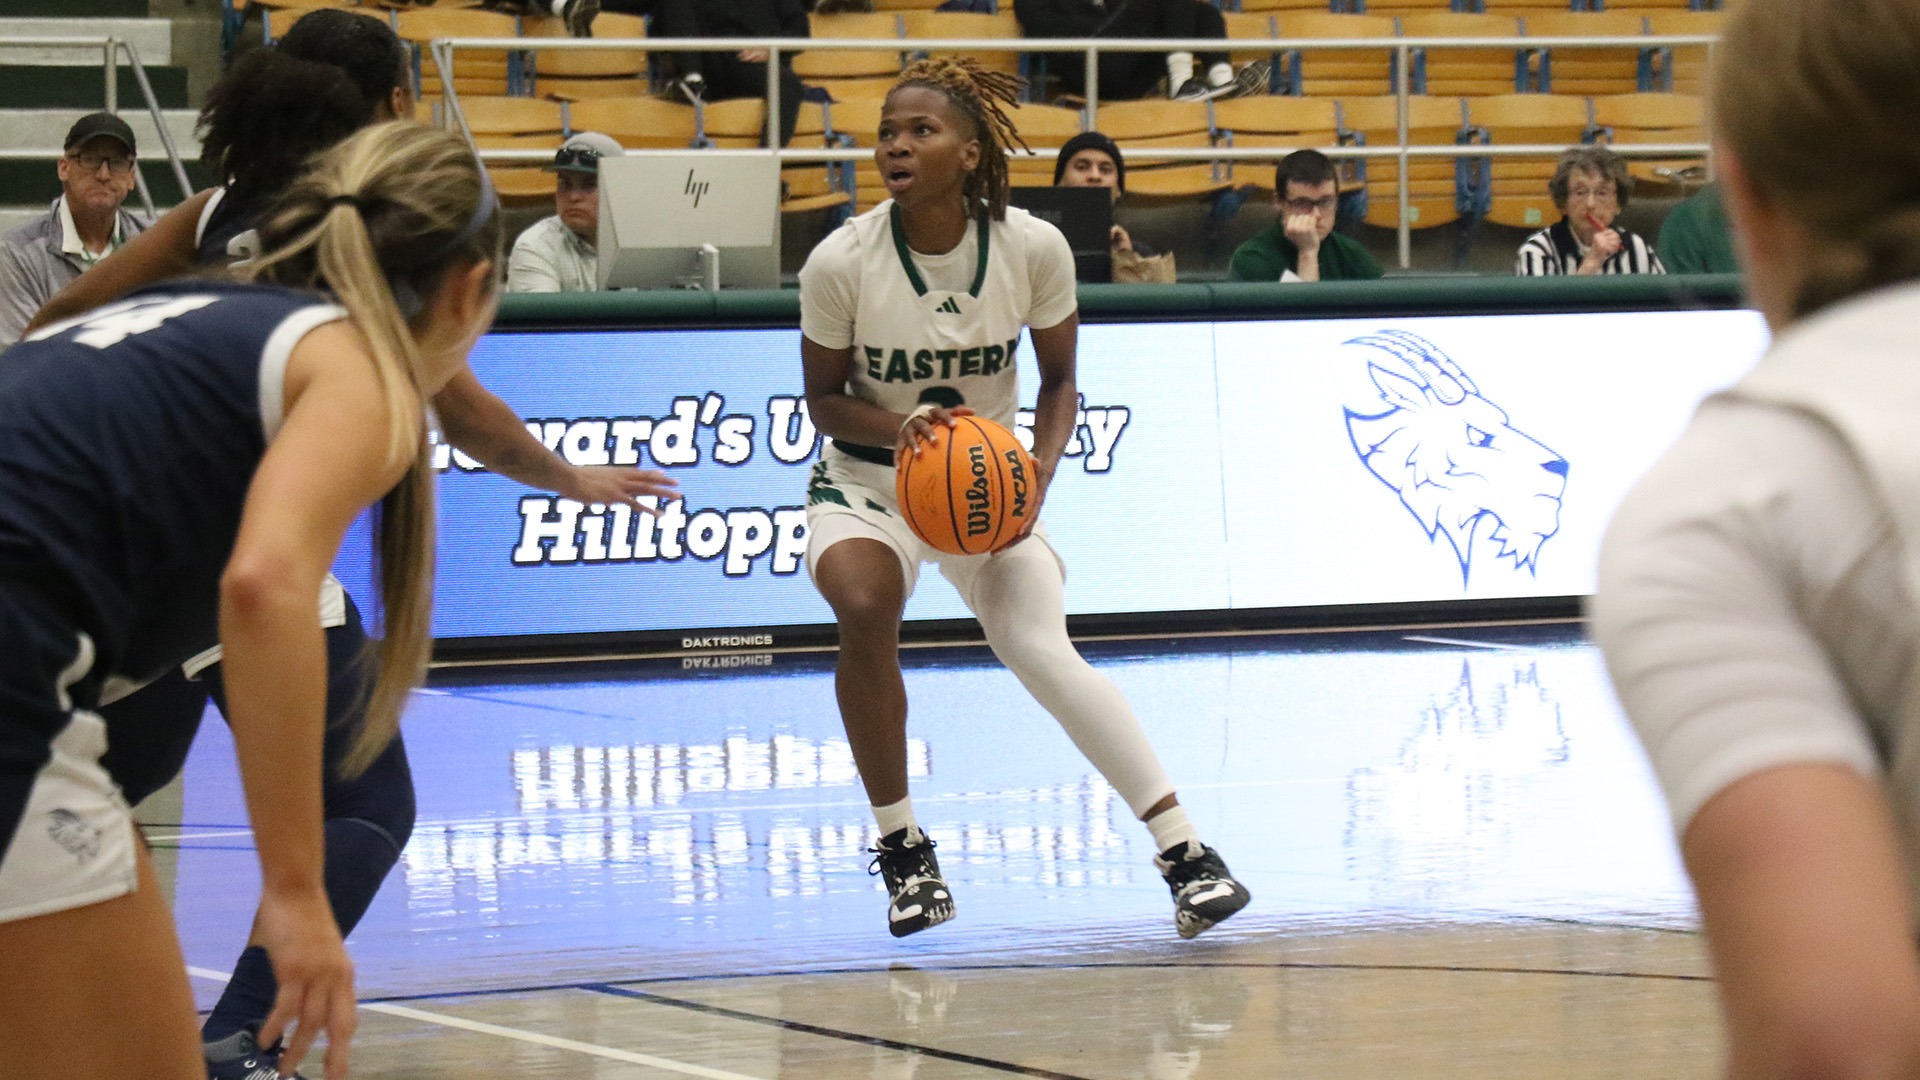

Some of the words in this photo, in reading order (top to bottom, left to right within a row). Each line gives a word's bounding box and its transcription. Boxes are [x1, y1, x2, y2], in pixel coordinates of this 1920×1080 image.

[684, 168, 710, 208] hp
[424, 393, 754, 468] ard's
[965, 445, 991, 537] Wilson
[1005, 449, 1027, 517] NCAA
[513, 496, 811, 575] Hilltopp
[682, 634, 773, 648] DAKTRONICS
